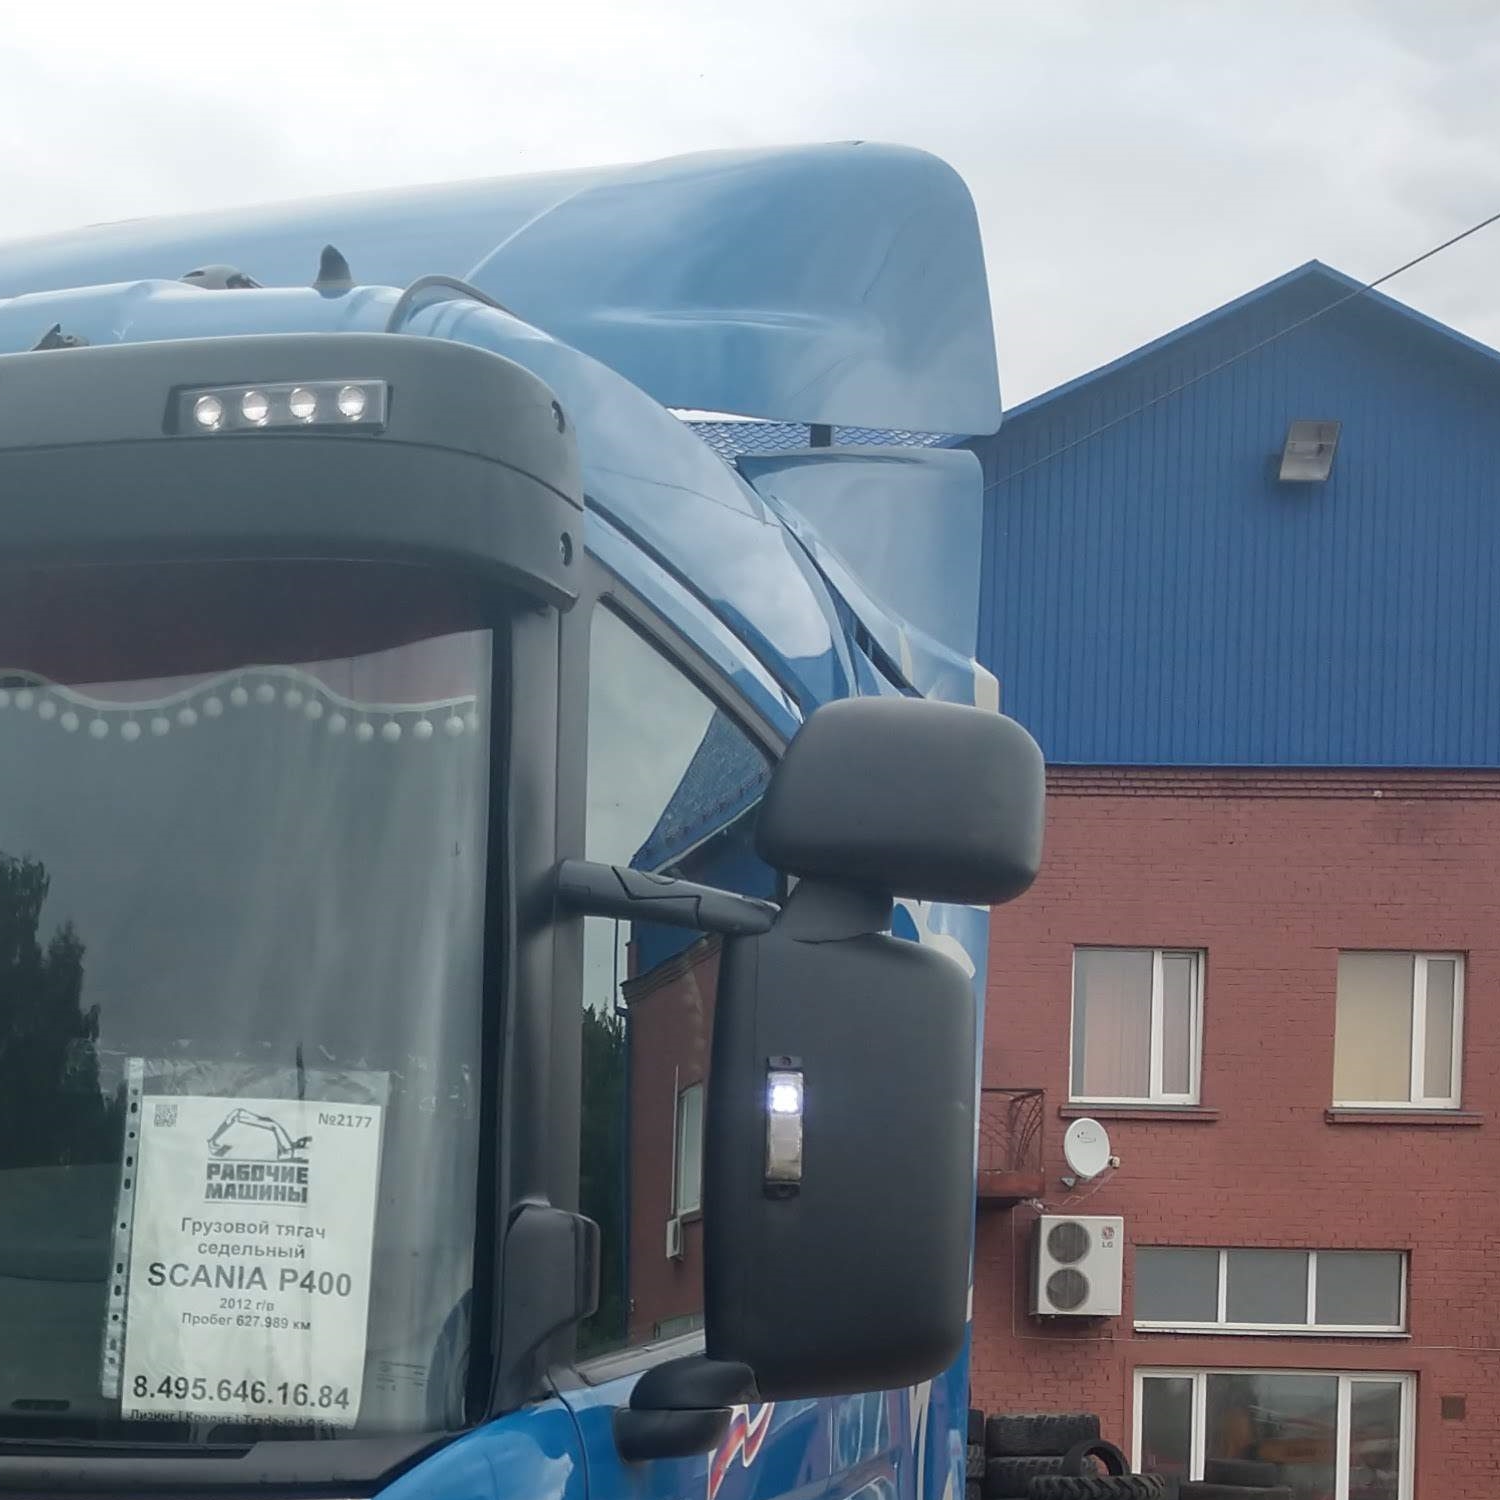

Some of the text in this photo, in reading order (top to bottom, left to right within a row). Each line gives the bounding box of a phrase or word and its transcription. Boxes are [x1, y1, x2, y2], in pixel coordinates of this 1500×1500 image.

[317, 1112, 373, 1129] №2177
[206, 1162, 310, 1185] РАБОЧИЕ
[204, 1182, 309, 1204] МАШИНЫ
[181, 1216, 327, 1240] Грузовой тягач
[197, 1242, 306, 1260] седельный
[1101, 1241, 1114, 1249] LG
[147, 1262, 353, 1298] SCANIA P400
[219, 1297, 276, 1313] 2012 г/в
[181, 1312, 312, 1331] Пробег 627.989 км
[132, 1374, 350, 1411] 8.495.646.16.84
